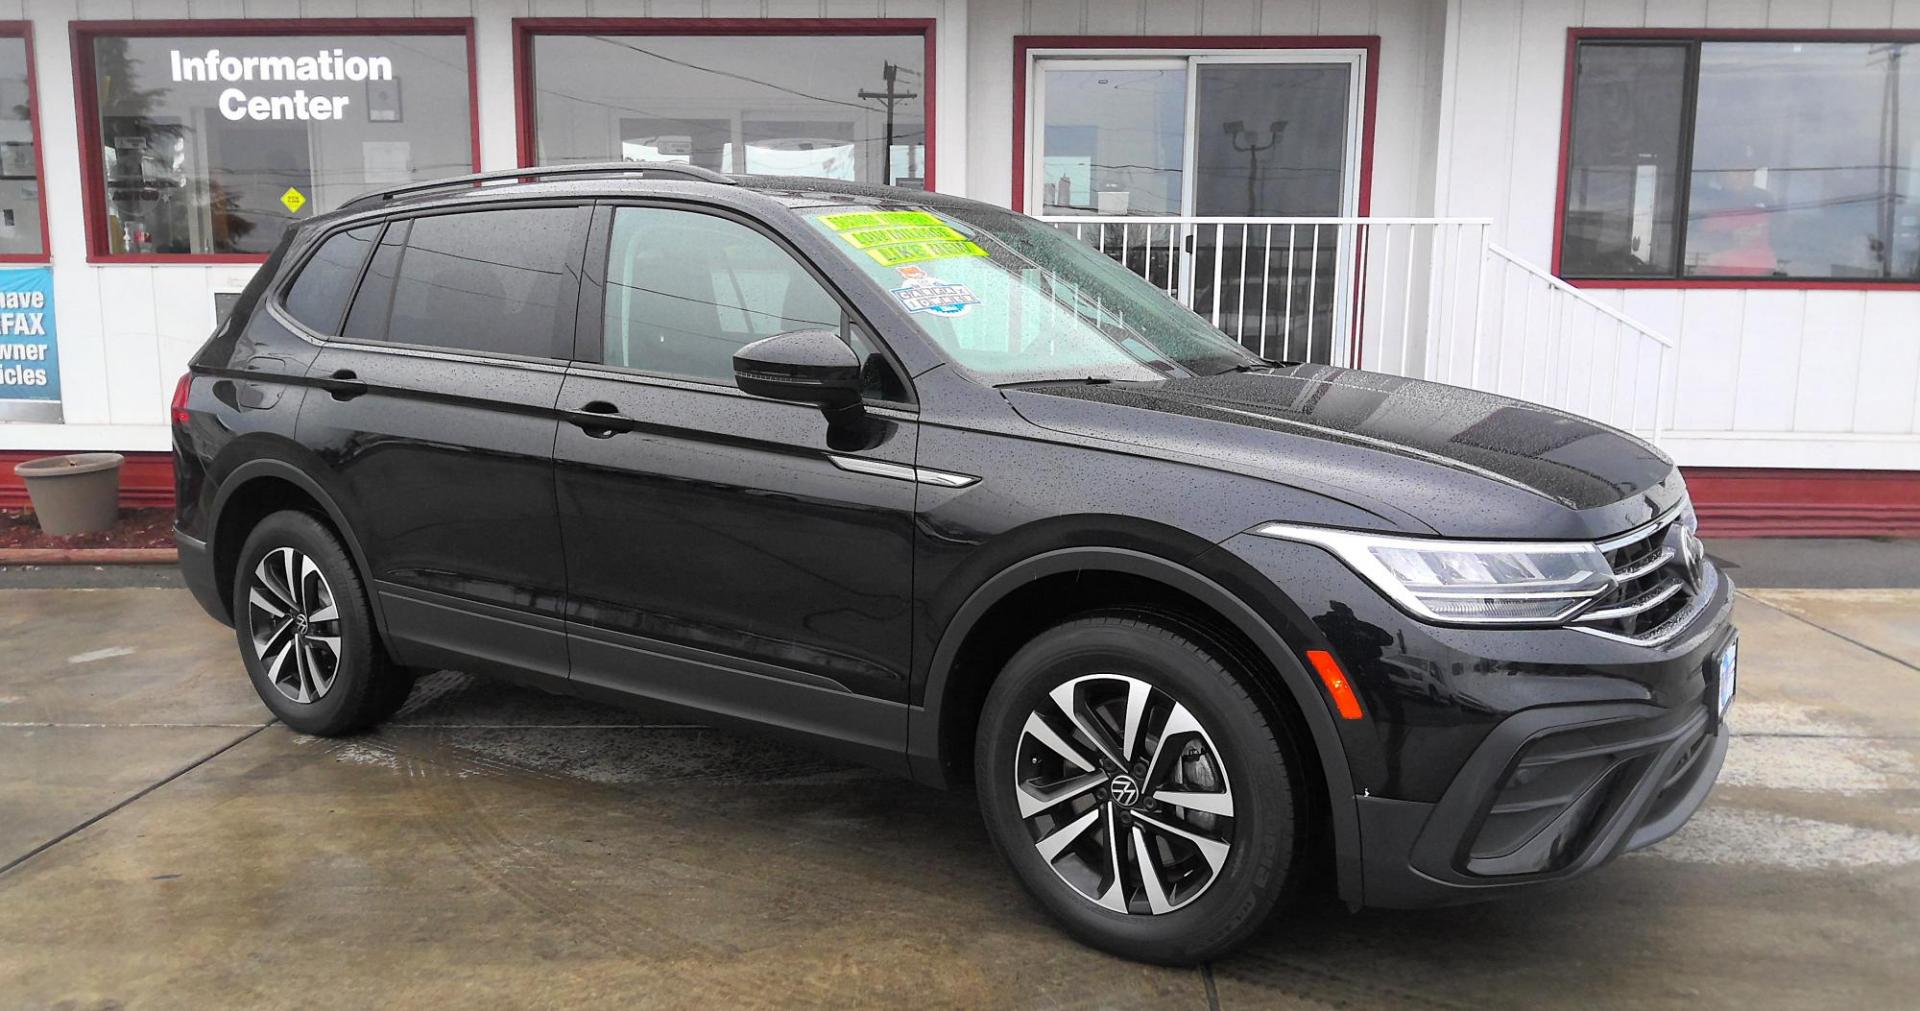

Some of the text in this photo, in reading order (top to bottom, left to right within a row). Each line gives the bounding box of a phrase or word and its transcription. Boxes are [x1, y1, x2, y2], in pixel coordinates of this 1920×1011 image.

[170, 48, 393, 82] Information
[218, 87, 350, 121] Center
[0, 312, 46, 336] FAX
